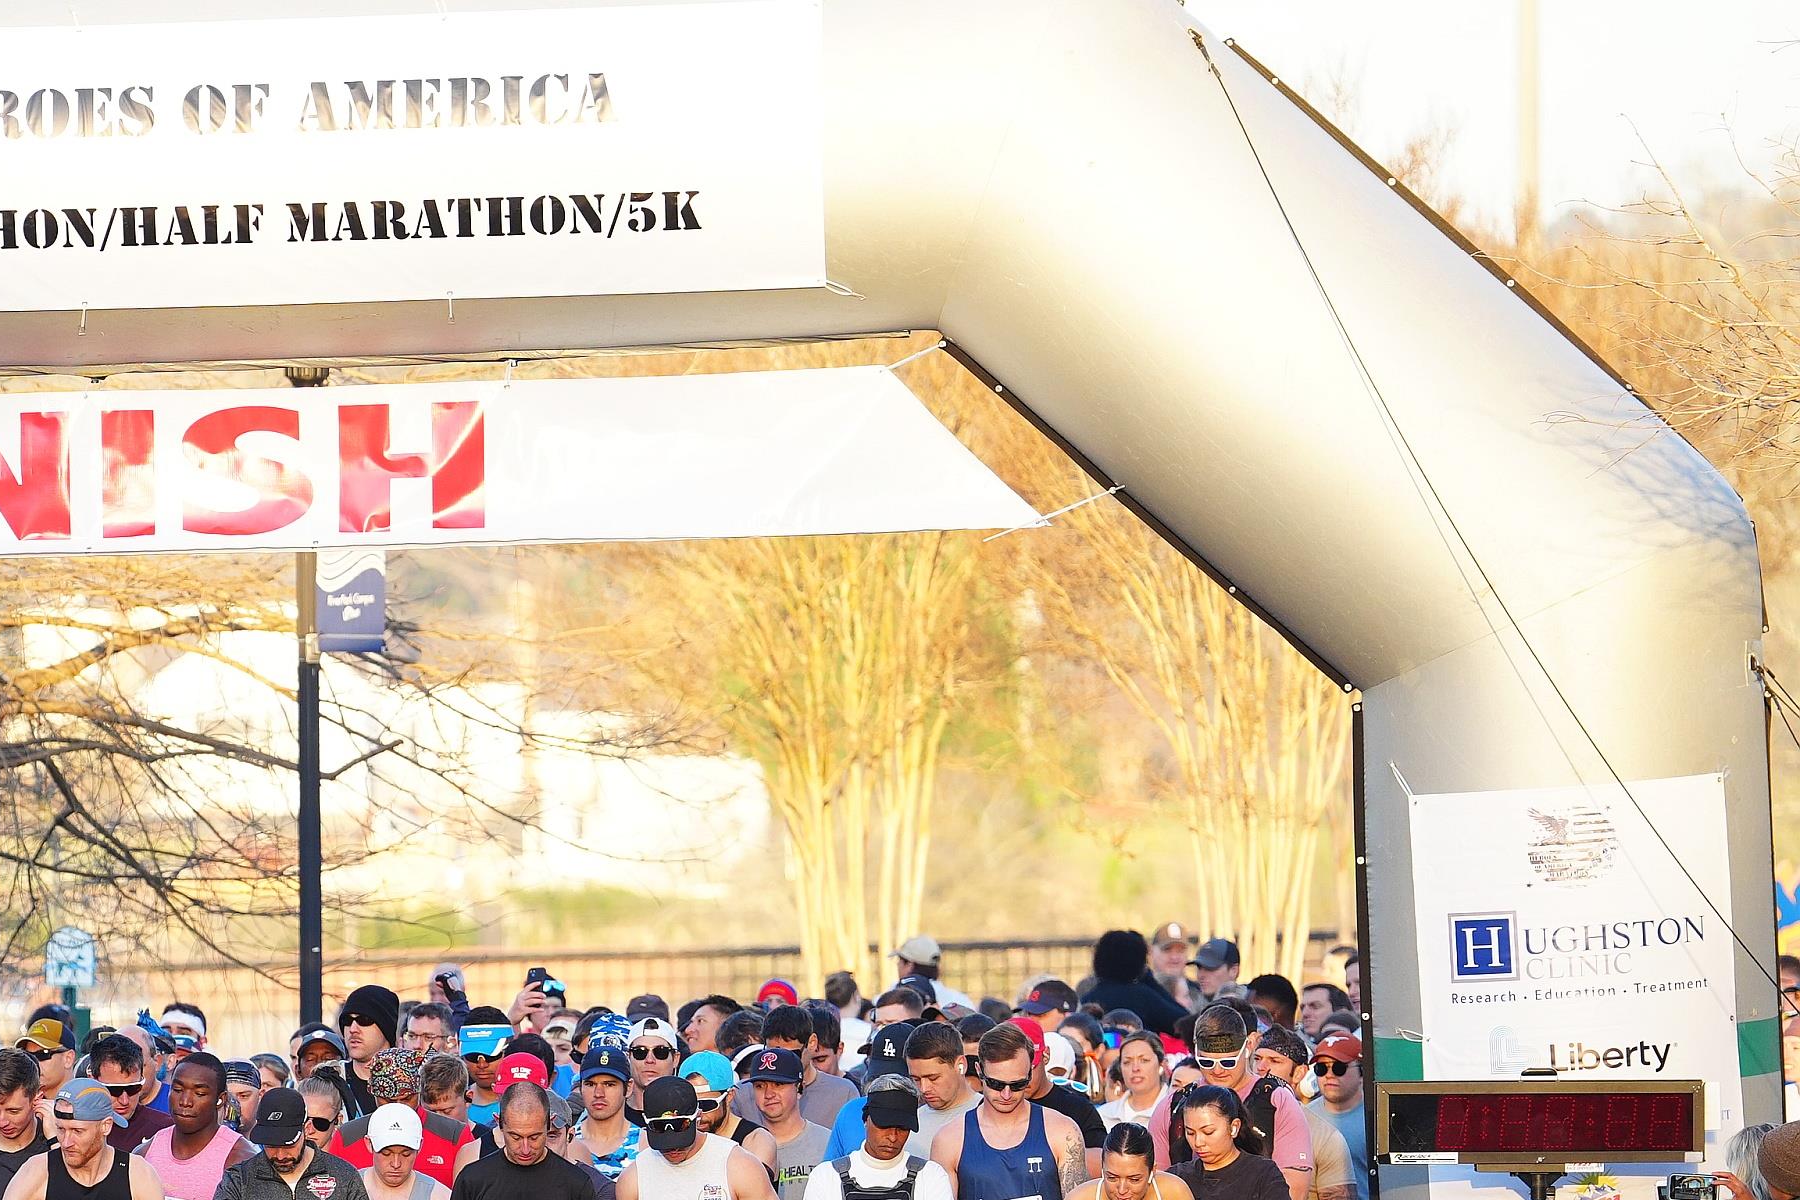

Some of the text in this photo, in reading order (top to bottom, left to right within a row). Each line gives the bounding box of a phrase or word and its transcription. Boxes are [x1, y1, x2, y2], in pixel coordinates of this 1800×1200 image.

[181, 83, 272, 135] OF
[296, 72, 619, 134] AMERICA
[286, 190, 703, 245] MARATHON/5K
[1526, 952, 1633, 980] CLINIC
[1452, 977, 1708, 1004] Research Education Treatment
[1549, 1041, 1671, 1072] Liberty
